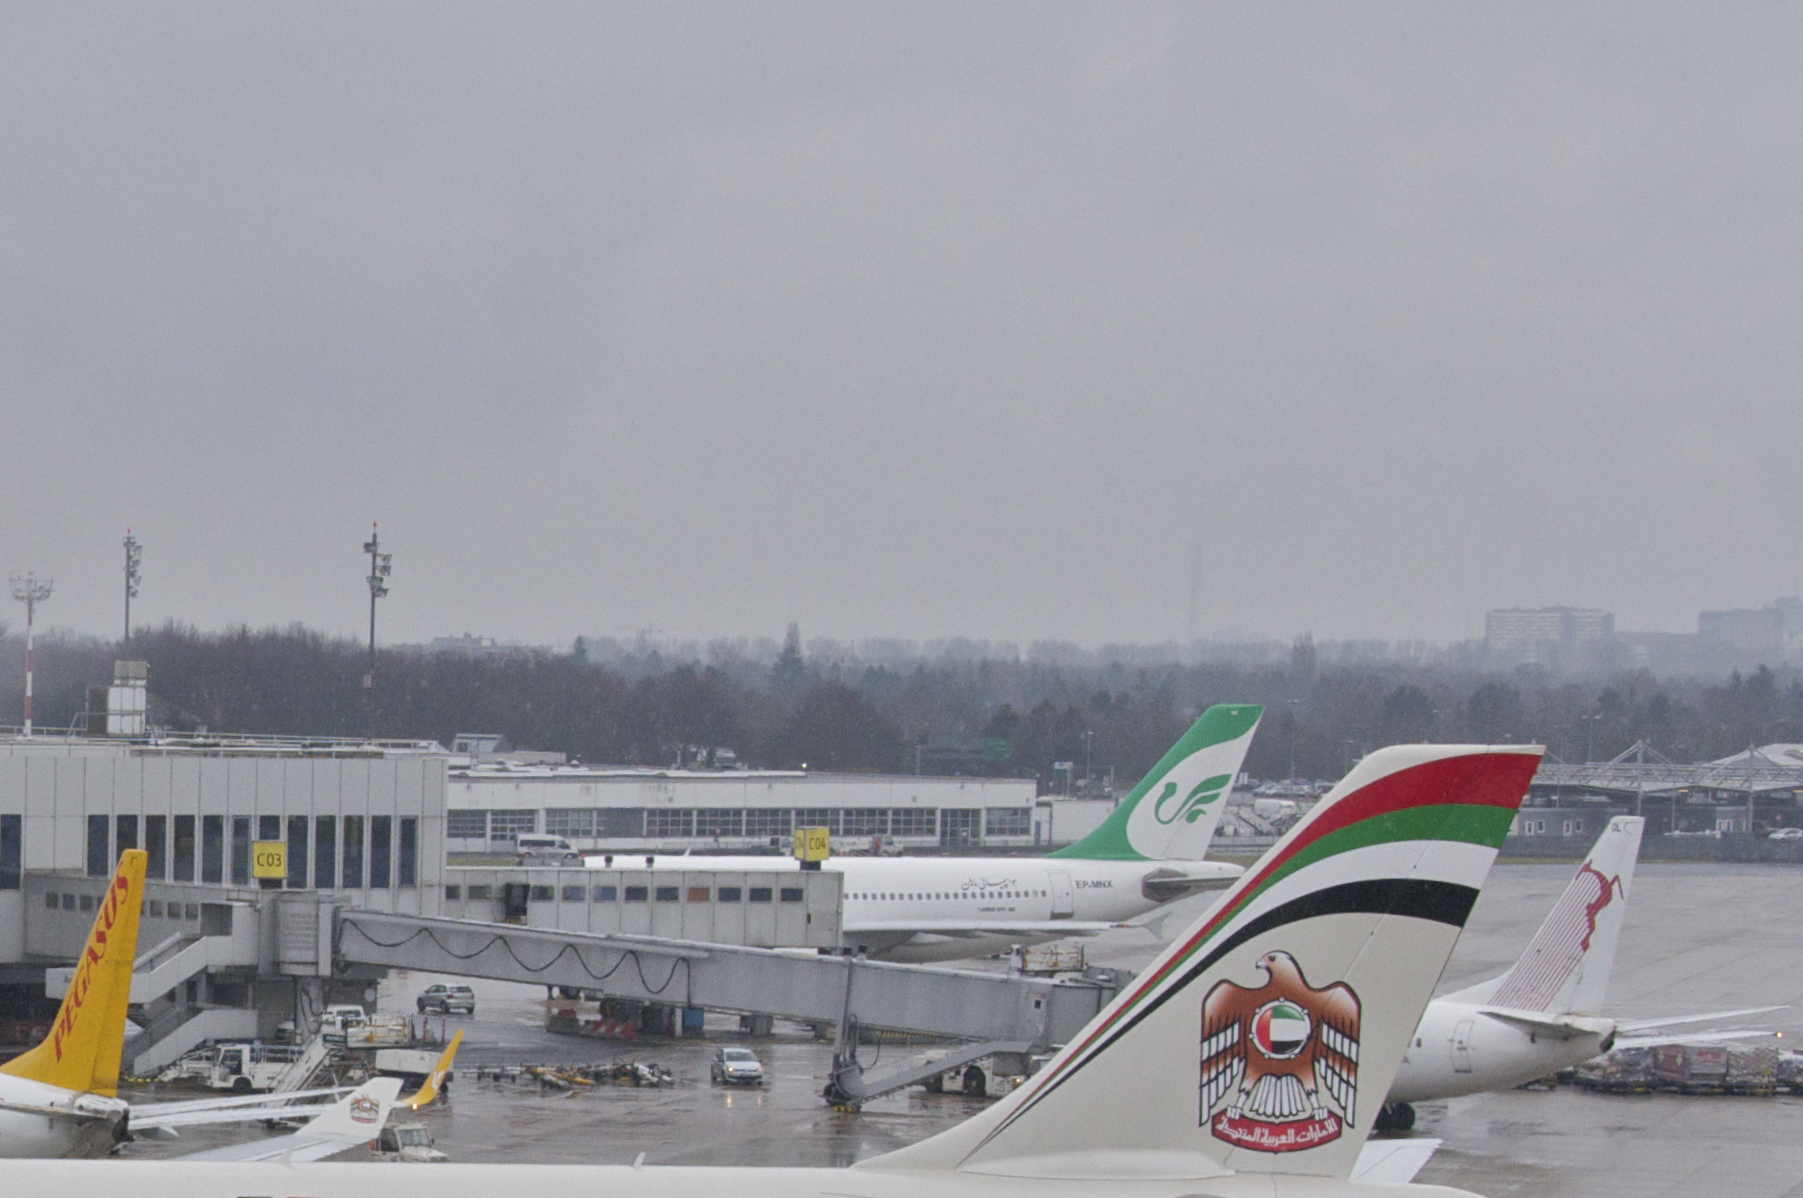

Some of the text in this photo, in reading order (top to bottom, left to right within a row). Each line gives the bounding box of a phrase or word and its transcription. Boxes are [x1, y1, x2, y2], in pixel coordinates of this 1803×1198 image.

[809, 837, 826, 850] C04
[257, 853, 281, 867] C03
[54, 861, 128, 1064] PEGASUS
